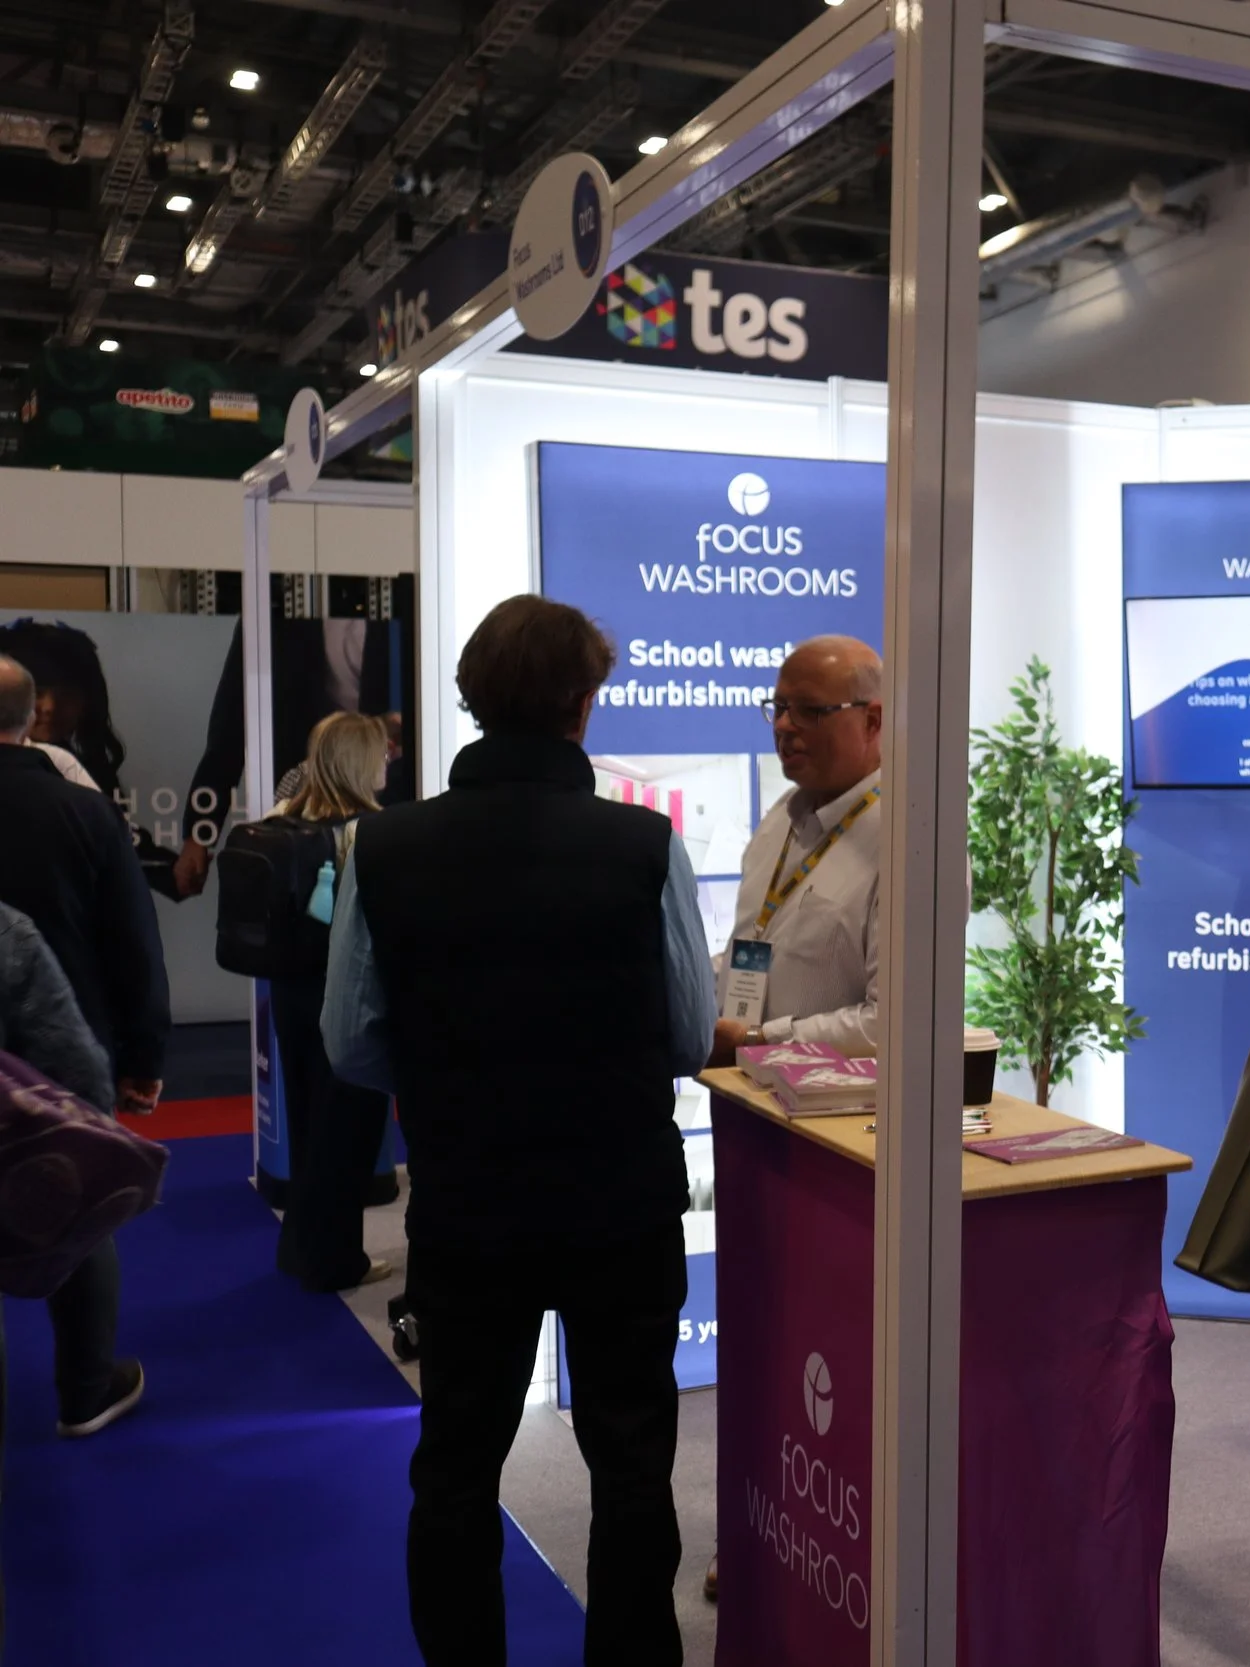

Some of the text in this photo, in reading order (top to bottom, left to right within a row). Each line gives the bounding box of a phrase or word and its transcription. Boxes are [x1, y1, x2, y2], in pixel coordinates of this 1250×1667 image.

[684, 269, 807, 362] tes
[119, 392, 191, 409] apetito
[639, 563, 858, 597] WASHROOMS
[629, 638, 725, 667] School
[1187, 692, 1247, 709] choosing
[113, 787, 248, 815] HOOL
[746, 1477, 869, 1629] WASHROO
